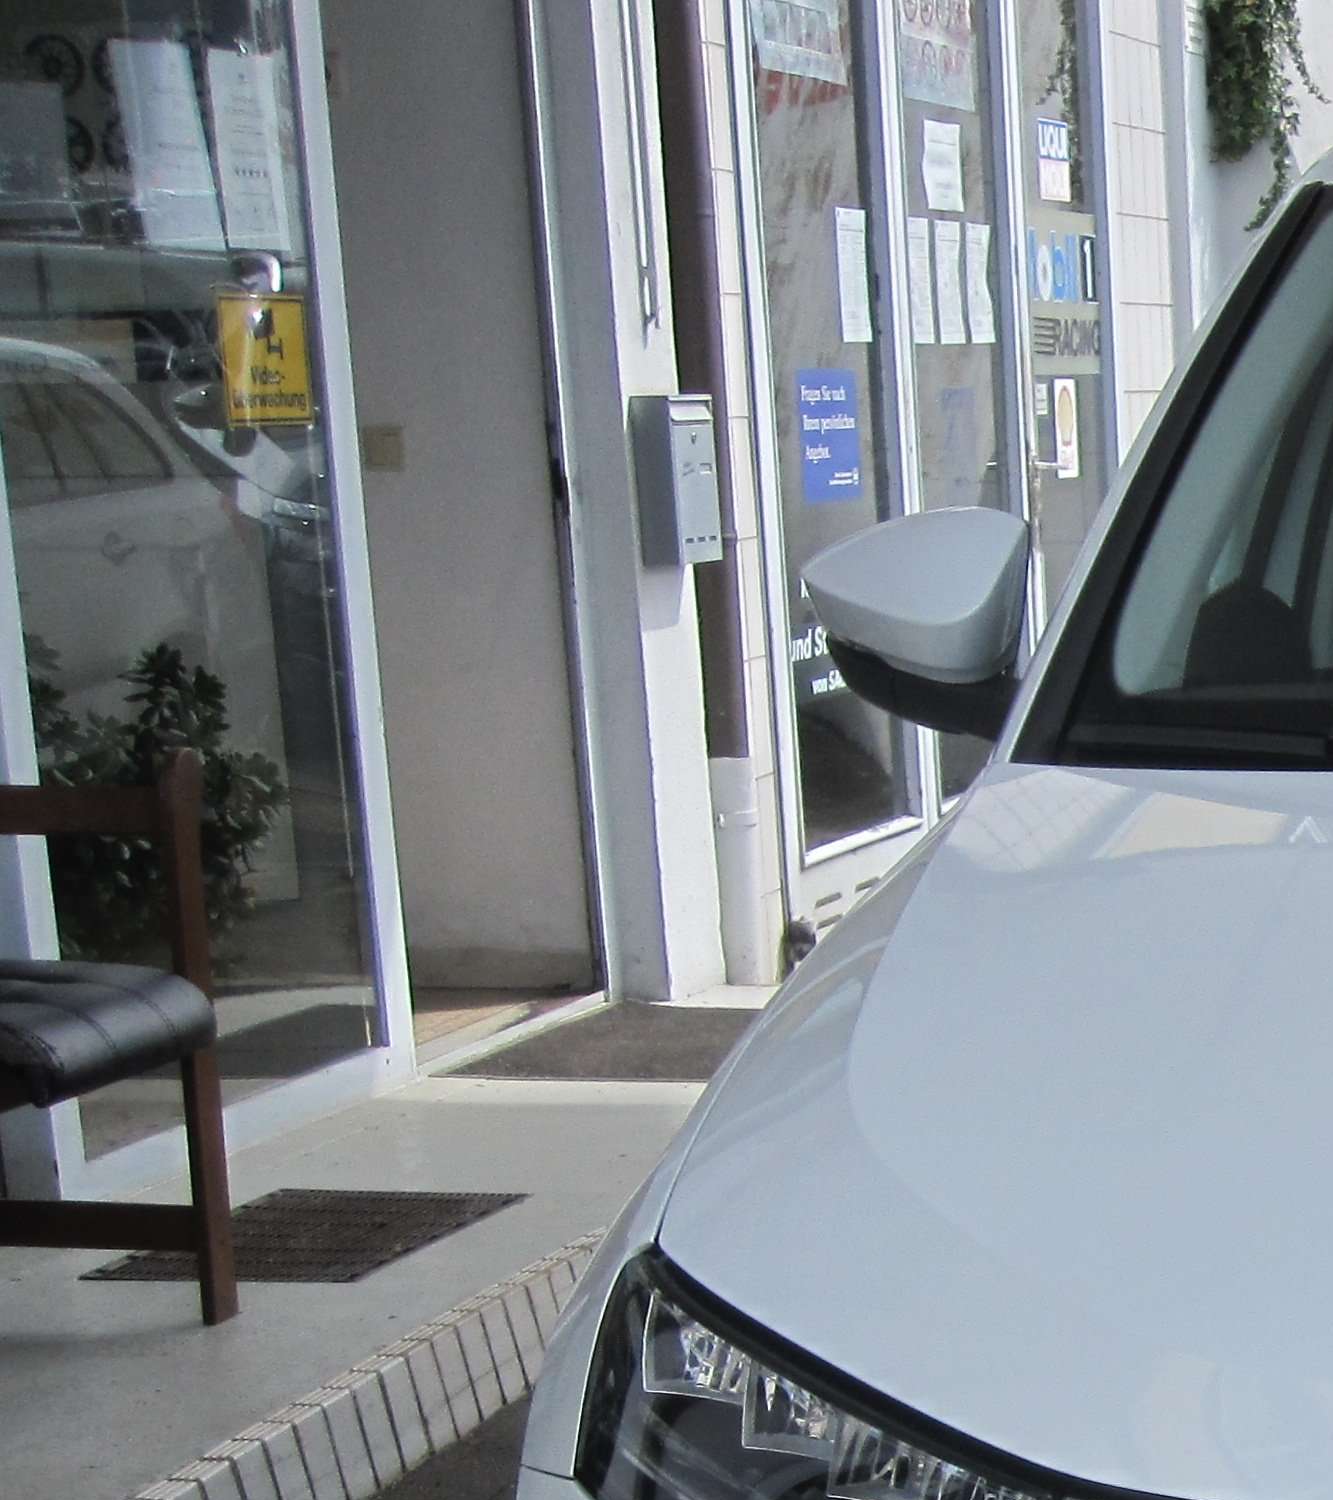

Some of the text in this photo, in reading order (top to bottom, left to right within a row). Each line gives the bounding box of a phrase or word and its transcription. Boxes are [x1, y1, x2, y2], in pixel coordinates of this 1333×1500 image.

[790, 625, 831, 662] und St
[828, 669, 849, 691] SA
